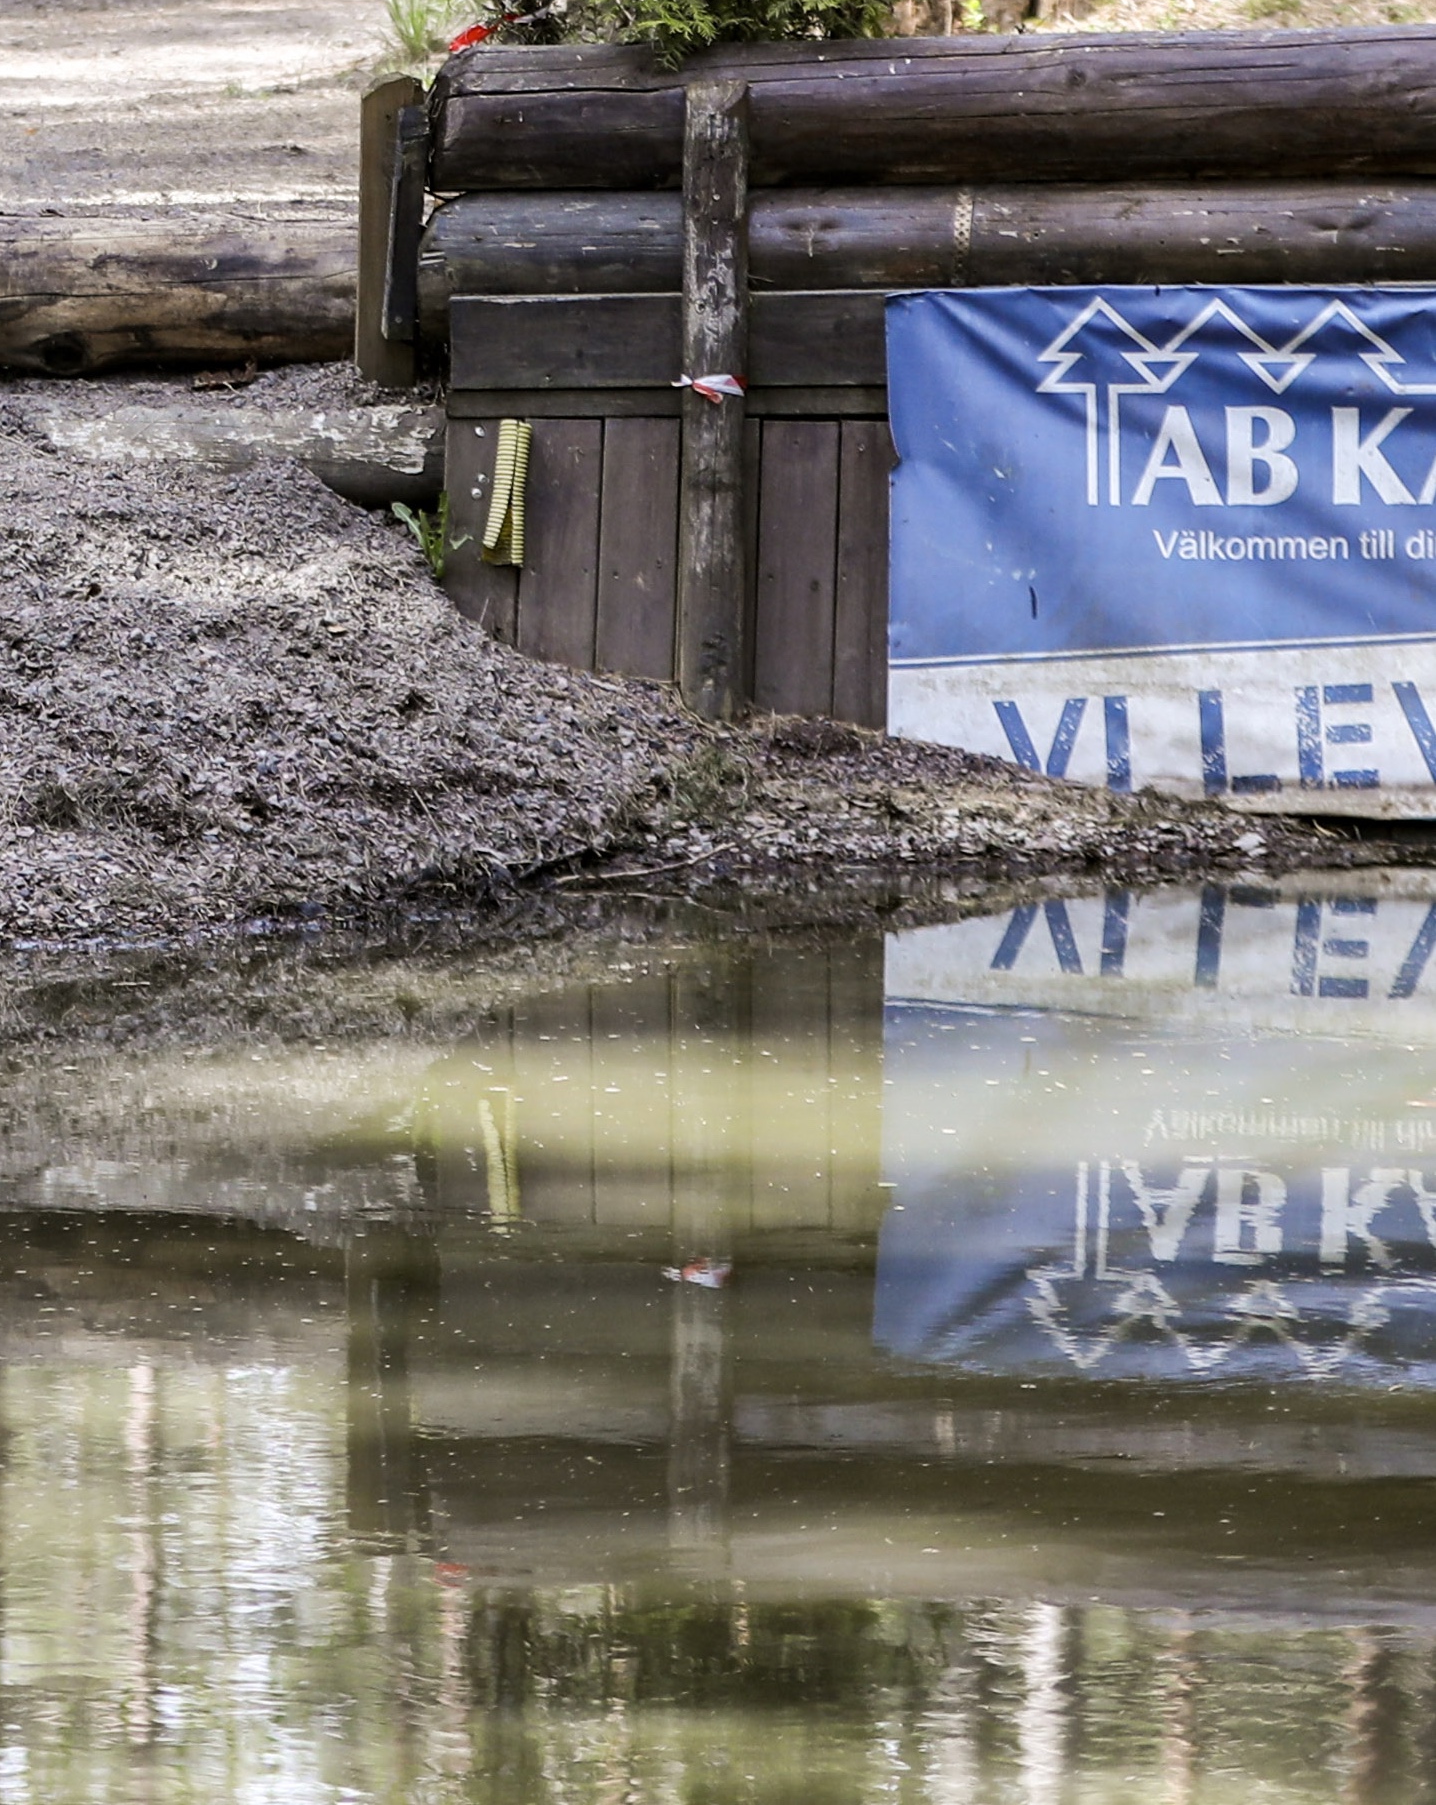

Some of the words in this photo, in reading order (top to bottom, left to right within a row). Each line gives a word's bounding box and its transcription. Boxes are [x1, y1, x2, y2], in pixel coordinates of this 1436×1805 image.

[1131, 406, 1299, 507] AB
[1331, 406, 1436, 506] K
[1153, 529, 1349, 560] Välkommen
[1358, 528, 1395, 560] till
[1405, 528, 1436, 560] di
